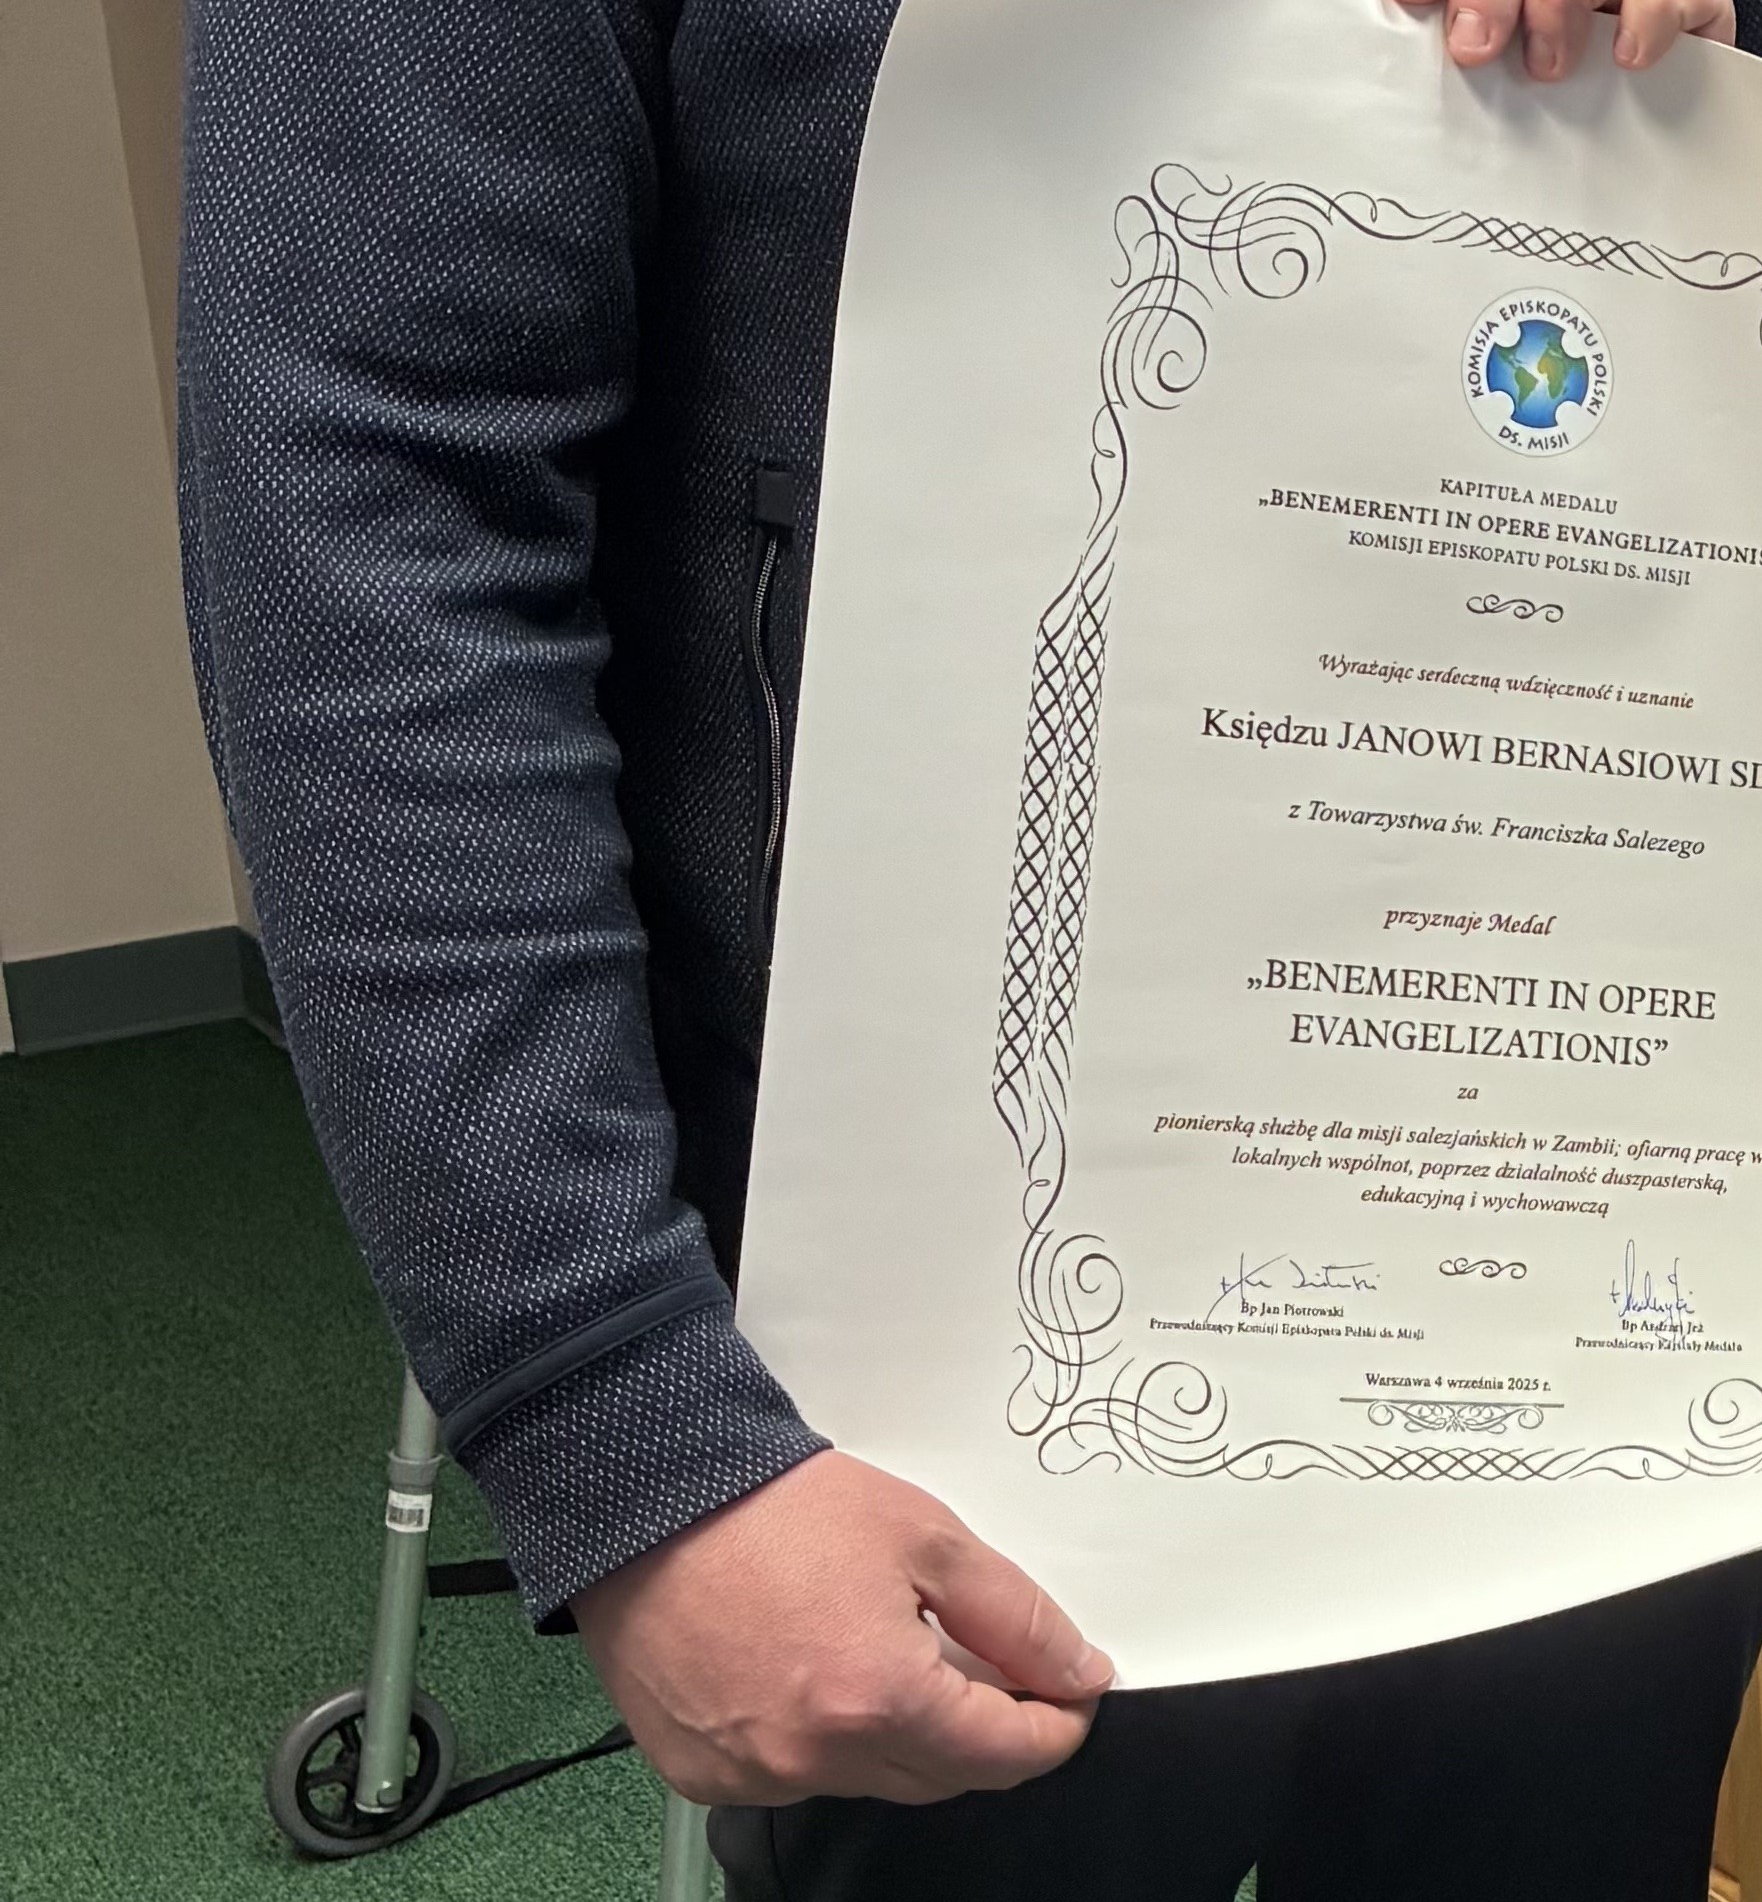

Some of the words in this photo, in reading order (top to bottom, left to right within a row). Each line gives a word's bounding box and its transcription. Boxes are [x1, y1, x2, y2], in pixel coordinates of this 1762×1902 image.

[1467, 320, 1499, 399] KOMISJA
[1499, 300, 1598, 350] EPISKOPATU
[1584, 352, 1608, 418] POLSKI
[1499, 425, 1523, 450] DS.
[1527, 431, 1571, 451] MISJI
[1439, 477, 1535, 505] KAPITUŁA
[1539, 490, 1618, 516] MEDALU
[1444, 509, 1473, 531] IN
[1477, 514, 1551, 540] OPERE
[1348, 529, 1424, 555] KOMISJI
[1427, 539, 1541, 568] EPISKOPATU
[1544, 553, 1609, 576] POLSKI
[1613, 561, 1641, 580] DS.
[1644, 566, 1691, 587] MISJI
[1318, 653, 1415, 684] Wyrażając
[1416, 665, 1501, 694] serdeczną
[1505, 674, 1615, 701] wdzięczność
[1615, 685, 1625, 703] i
[1627, 691, 1695, 709] uznanie
[1200, 706, 1329, 750] Księdzu
[1336, 720, 1484, 763] JANOWI
[1490, 736, 1721, 786] BERNASIOWI
[1287, 804, 1302, 819] z
[1306, 799, 1448, 833] Towarzystwa
[1450, 813, 1483, 836] św.
[1489, 816, 1609, 847] Franciszka
[1612, 827, 1706, 860] Salezego
[1382, 909, 1483, 937] przyznaje
[1486, 913, 1558, 937] Medal
[1546, 979, 1591, 1012] IN
[1598, 983, 1717, 1021] OPERE
[1456, 1087, 1480, 1101] za
[1152, 1112, 1256, 1139] pionierską
[1258, 1116, 1319, 1142] służbę
[1321, 1120, 1353, 1140] dla
[1356, 1124, 1404, 1147] misji
[1405, 1126, 1527, 1150] salezjańskich
[1532, 1137, 1548, 1151] w
[1550, 1134, 1622, 1158] Zambii;
[1626, 1139, 1692, 1164] ofiarną
[1692, 1148, 1747, 1167] pracę
[1231, 1145, 1323, 1172] lokalnych
[1327, 1153, 1414, 1177] wspólnot,
[1416, 1162, 1492, 1181] poprzez
[1494, 1160, 1598, 1184] działalność
[1601, 1166, 1728, 1196] duszpasterską,
[1360, 1184, 1466, 1212] edukacyjną
[1469, 1190, 1479, 1208] i
[1482, 1191, 1610, 1220] wychowawczą
[1241, 1299, 1257, 1317] Bp
[1261, 1302, 1280, 1317] Jan
[1365, 1372, 1431, 1387] Warszawa
[1435, 1376, 1444, 1387] 4
[1447, 1375, 1504, 1390] września
[1507, 1377, 1540, 1391] 2025
